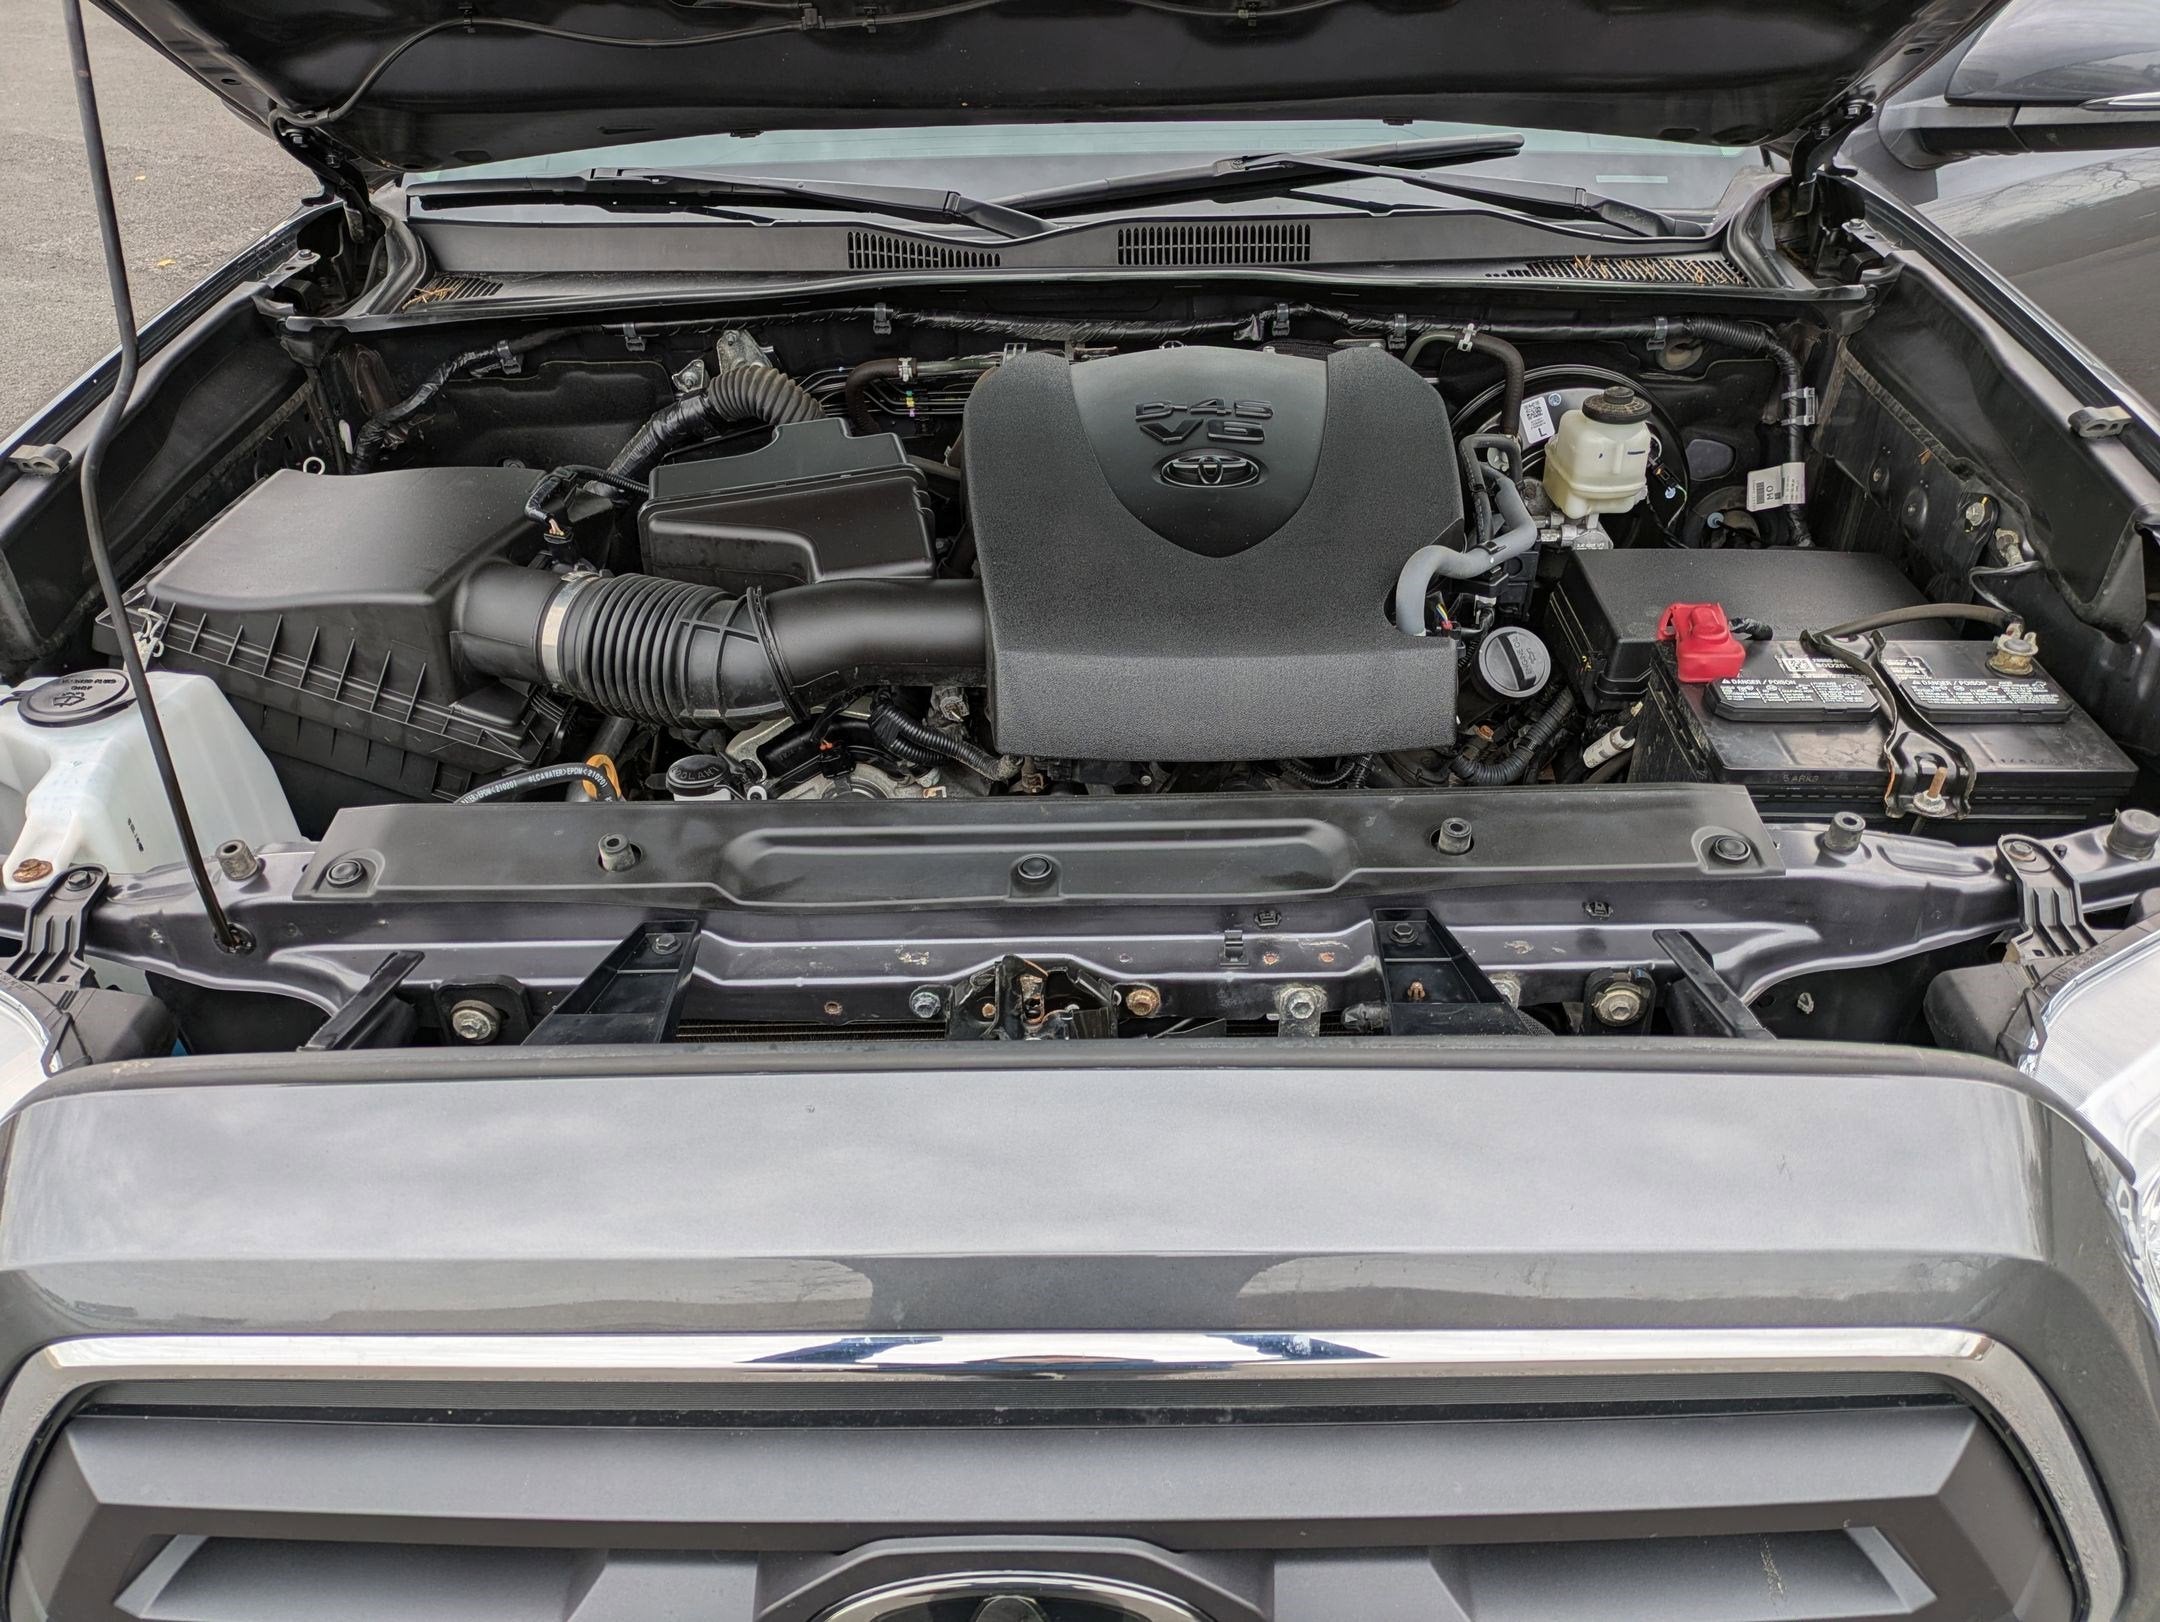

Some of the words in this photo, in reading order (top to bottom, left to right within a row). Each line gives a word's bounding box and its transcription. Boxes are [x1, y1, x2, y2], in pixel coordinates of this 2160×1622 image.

[1135, 398, 1274, 421] D-4S
[1139, 418, 1265, 444] V6
[1537, 427, 1548, 437] L
[1765, 485, 1774, 501] MO
